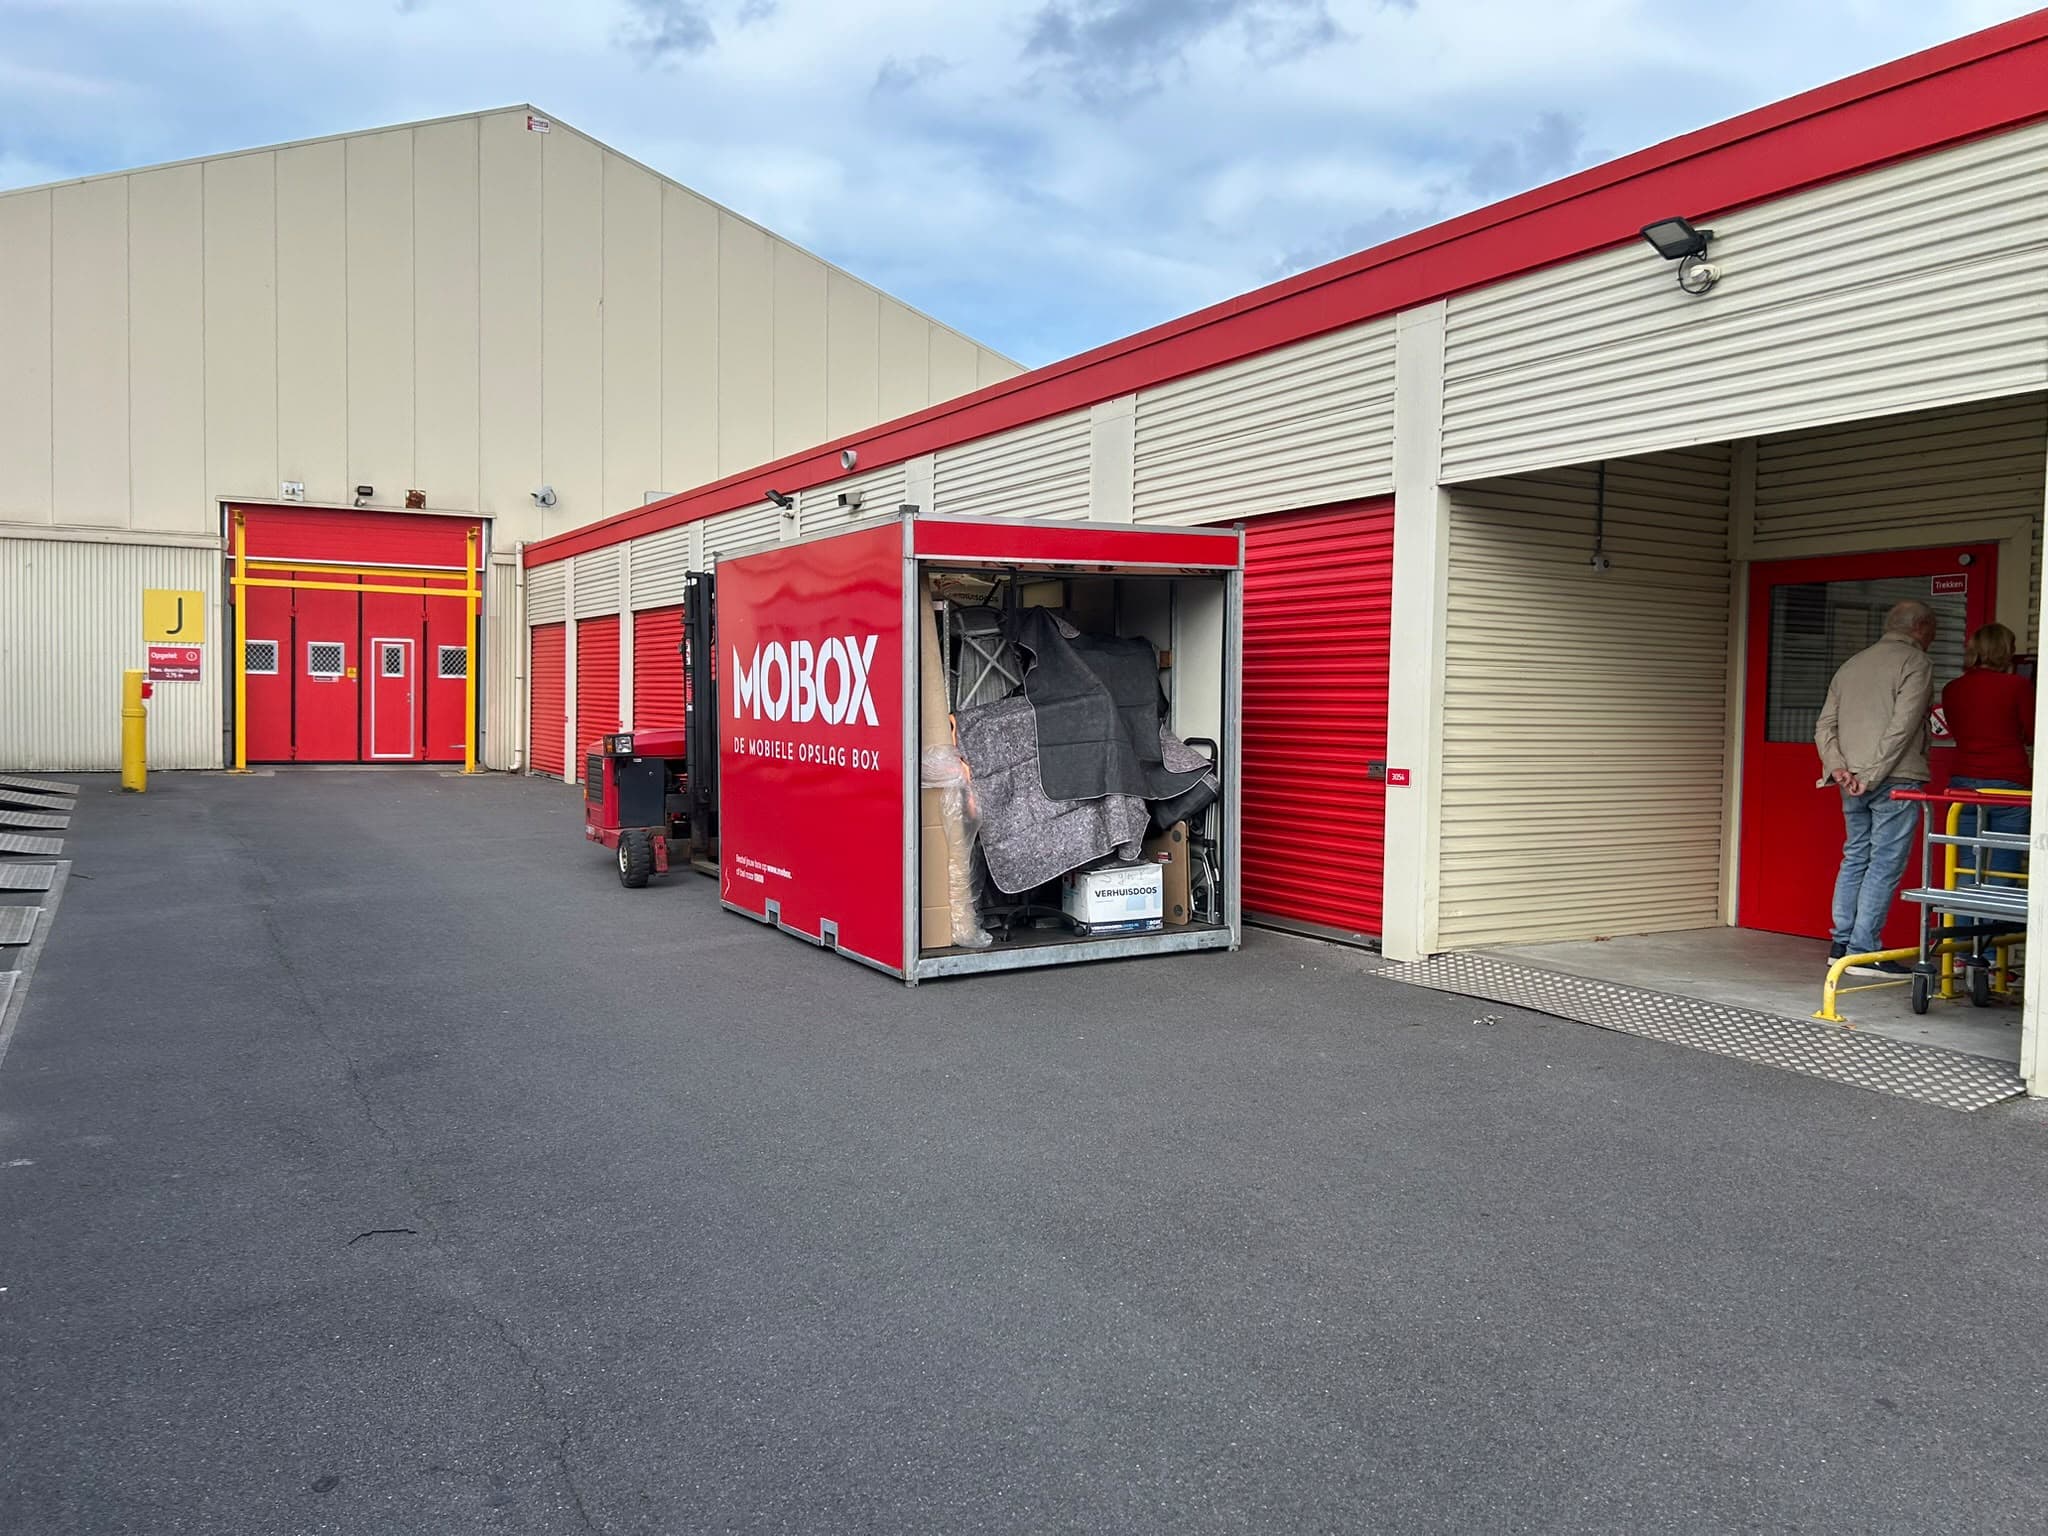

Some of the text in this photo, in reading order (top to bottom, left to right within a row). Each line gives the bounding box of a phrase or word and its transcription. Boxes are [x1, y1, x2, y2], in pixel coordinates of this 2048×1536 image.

[1935, 580, 1963, 589] Trekken
[165, 597, 183, 635] J
[151, 652, 177, 660] Opgelet
[732, 634, 880, 727] MOBOX
[733, 736, 880, 771] DE MOBIELE OPSLAG BOX
[1094, 886, 1158, 898] VERHUISDOOS
